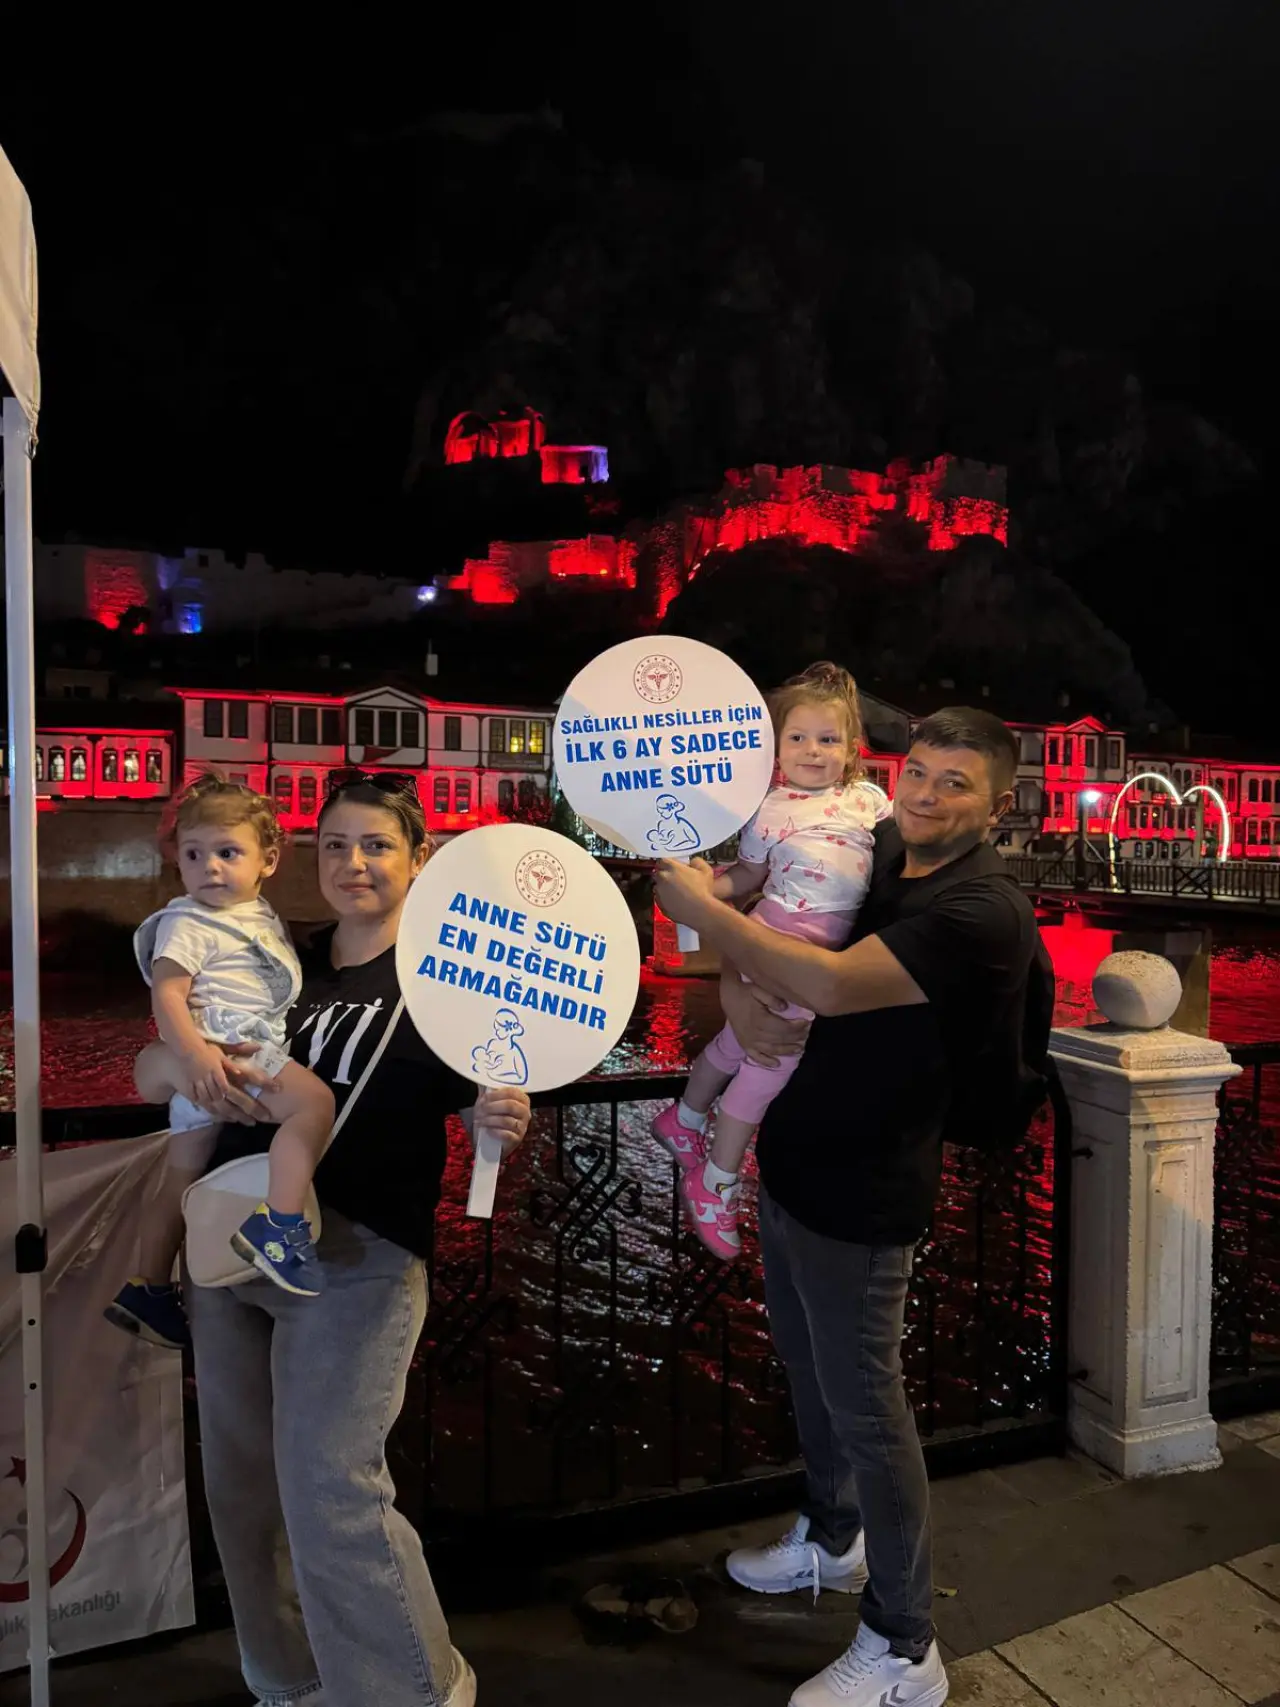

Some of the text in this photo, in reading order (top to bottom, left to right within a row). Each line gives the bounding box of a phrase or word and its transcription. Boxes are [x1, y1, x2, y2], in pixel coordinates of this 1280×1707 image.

[560, 703, 763, 735] SAĞLIKLI NESİLLER İÇİN
[565, 729, 762, 764] İLK 6 AY SADECE
[600, 757, 733, 793] ANNE SÜTÜ
[448, 892, 607, 962] ANNE SÜTÜ
[437, 922, 604, 995] EN DEĞERLİ
[416, 954, 607, 1031] ARMAĞANDIR
[0, 1591, 120, 1641] lık akanlığı
